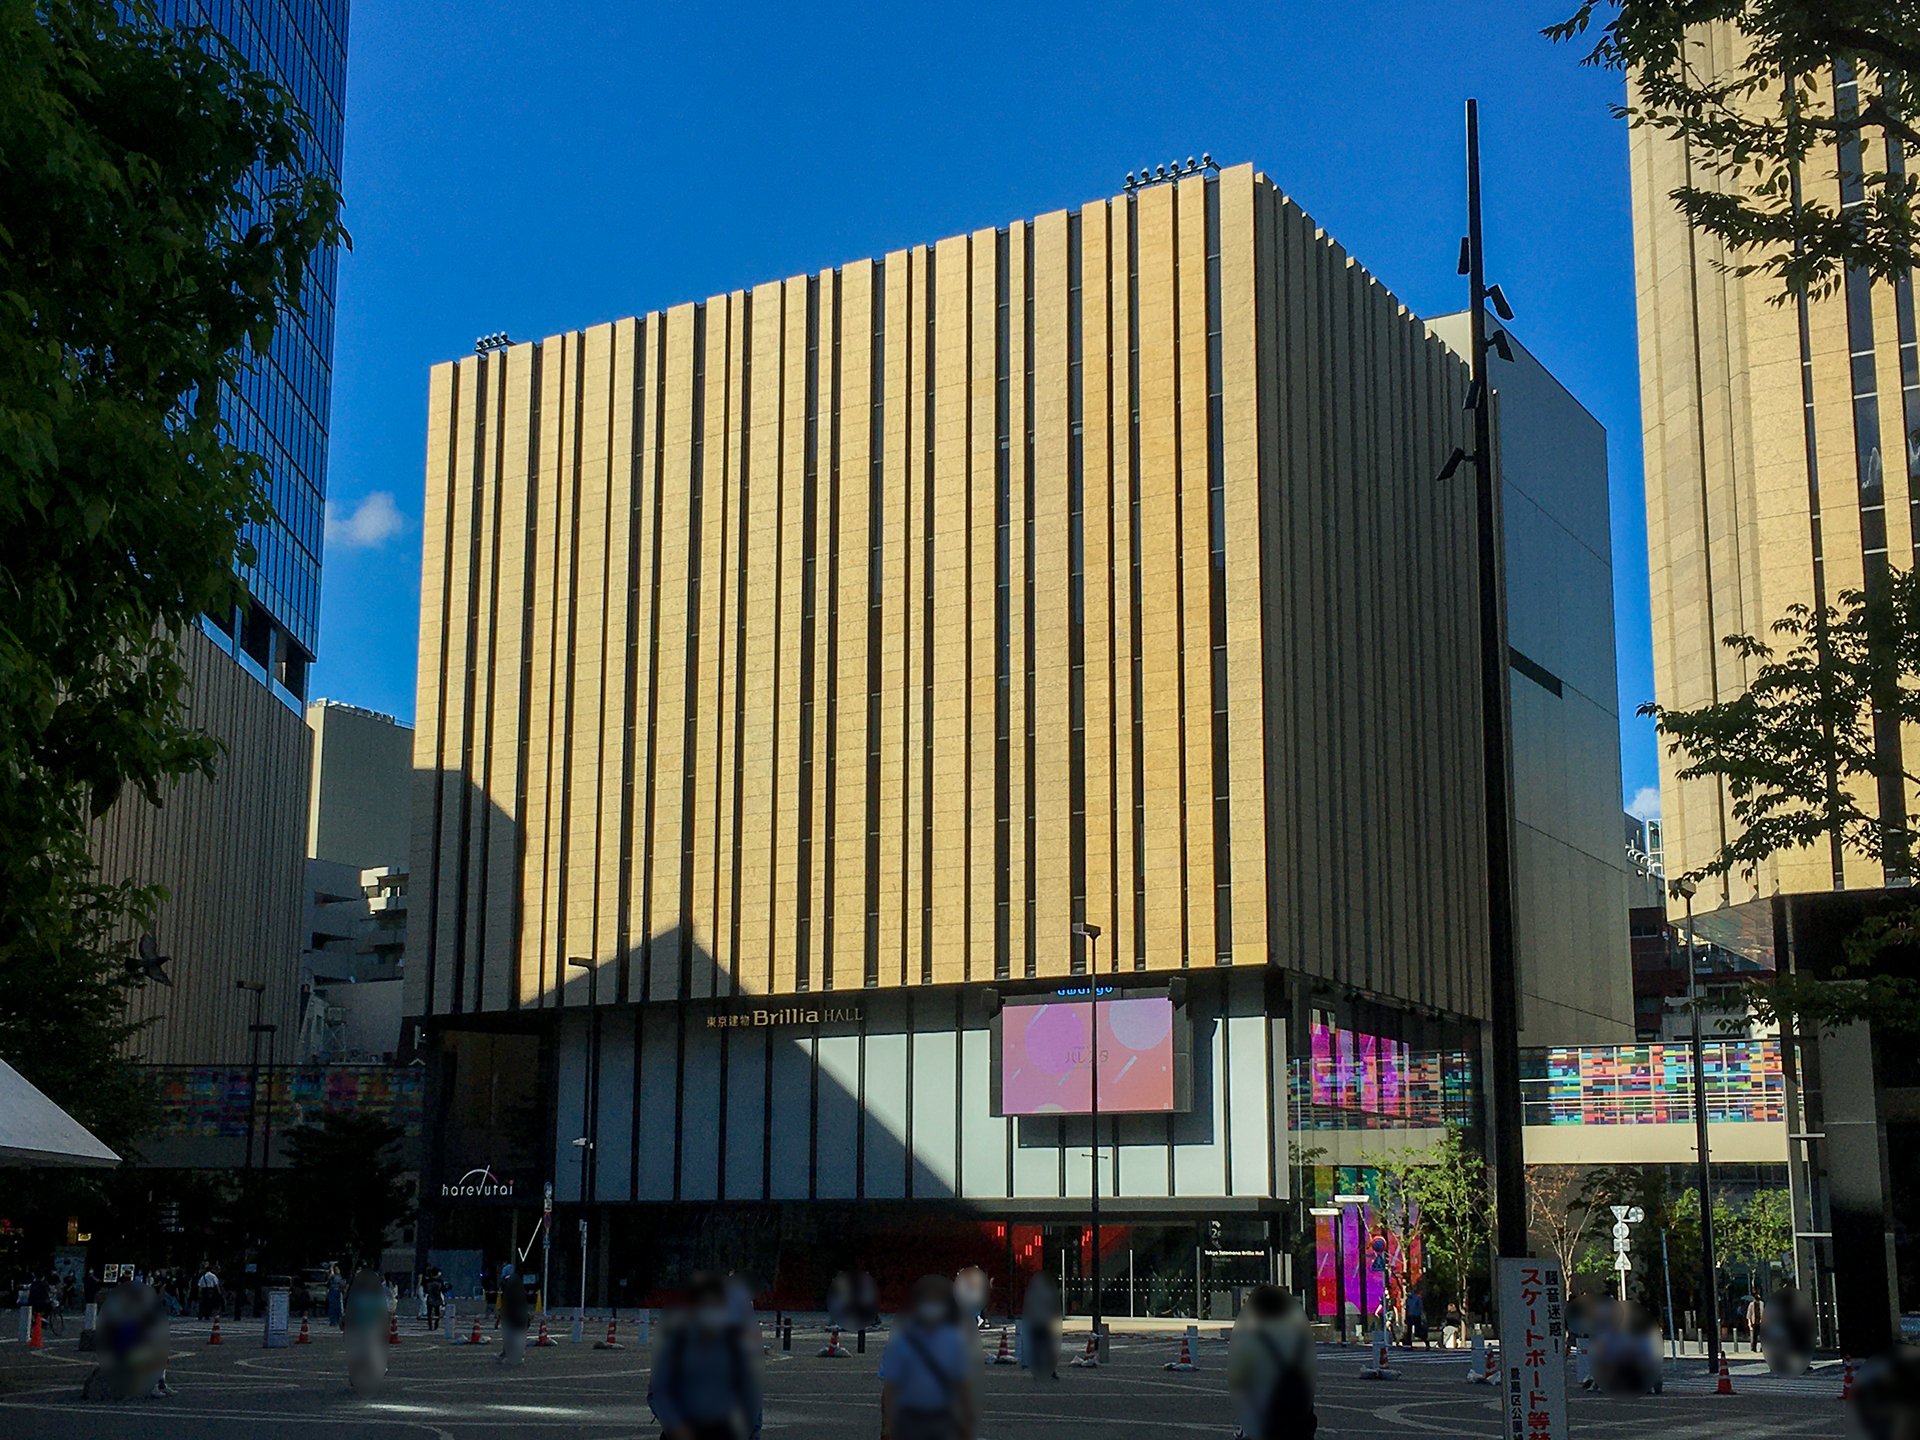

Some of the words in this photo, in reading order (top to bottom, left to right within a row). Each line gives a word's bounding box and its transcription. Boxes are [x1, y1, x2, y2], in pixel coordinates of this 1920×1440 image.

[706, 1013, 750, 1028] 東京建物
[753, 1008, 819, 1026] Brillia
[823, 1007, 863, 1023] HALL
